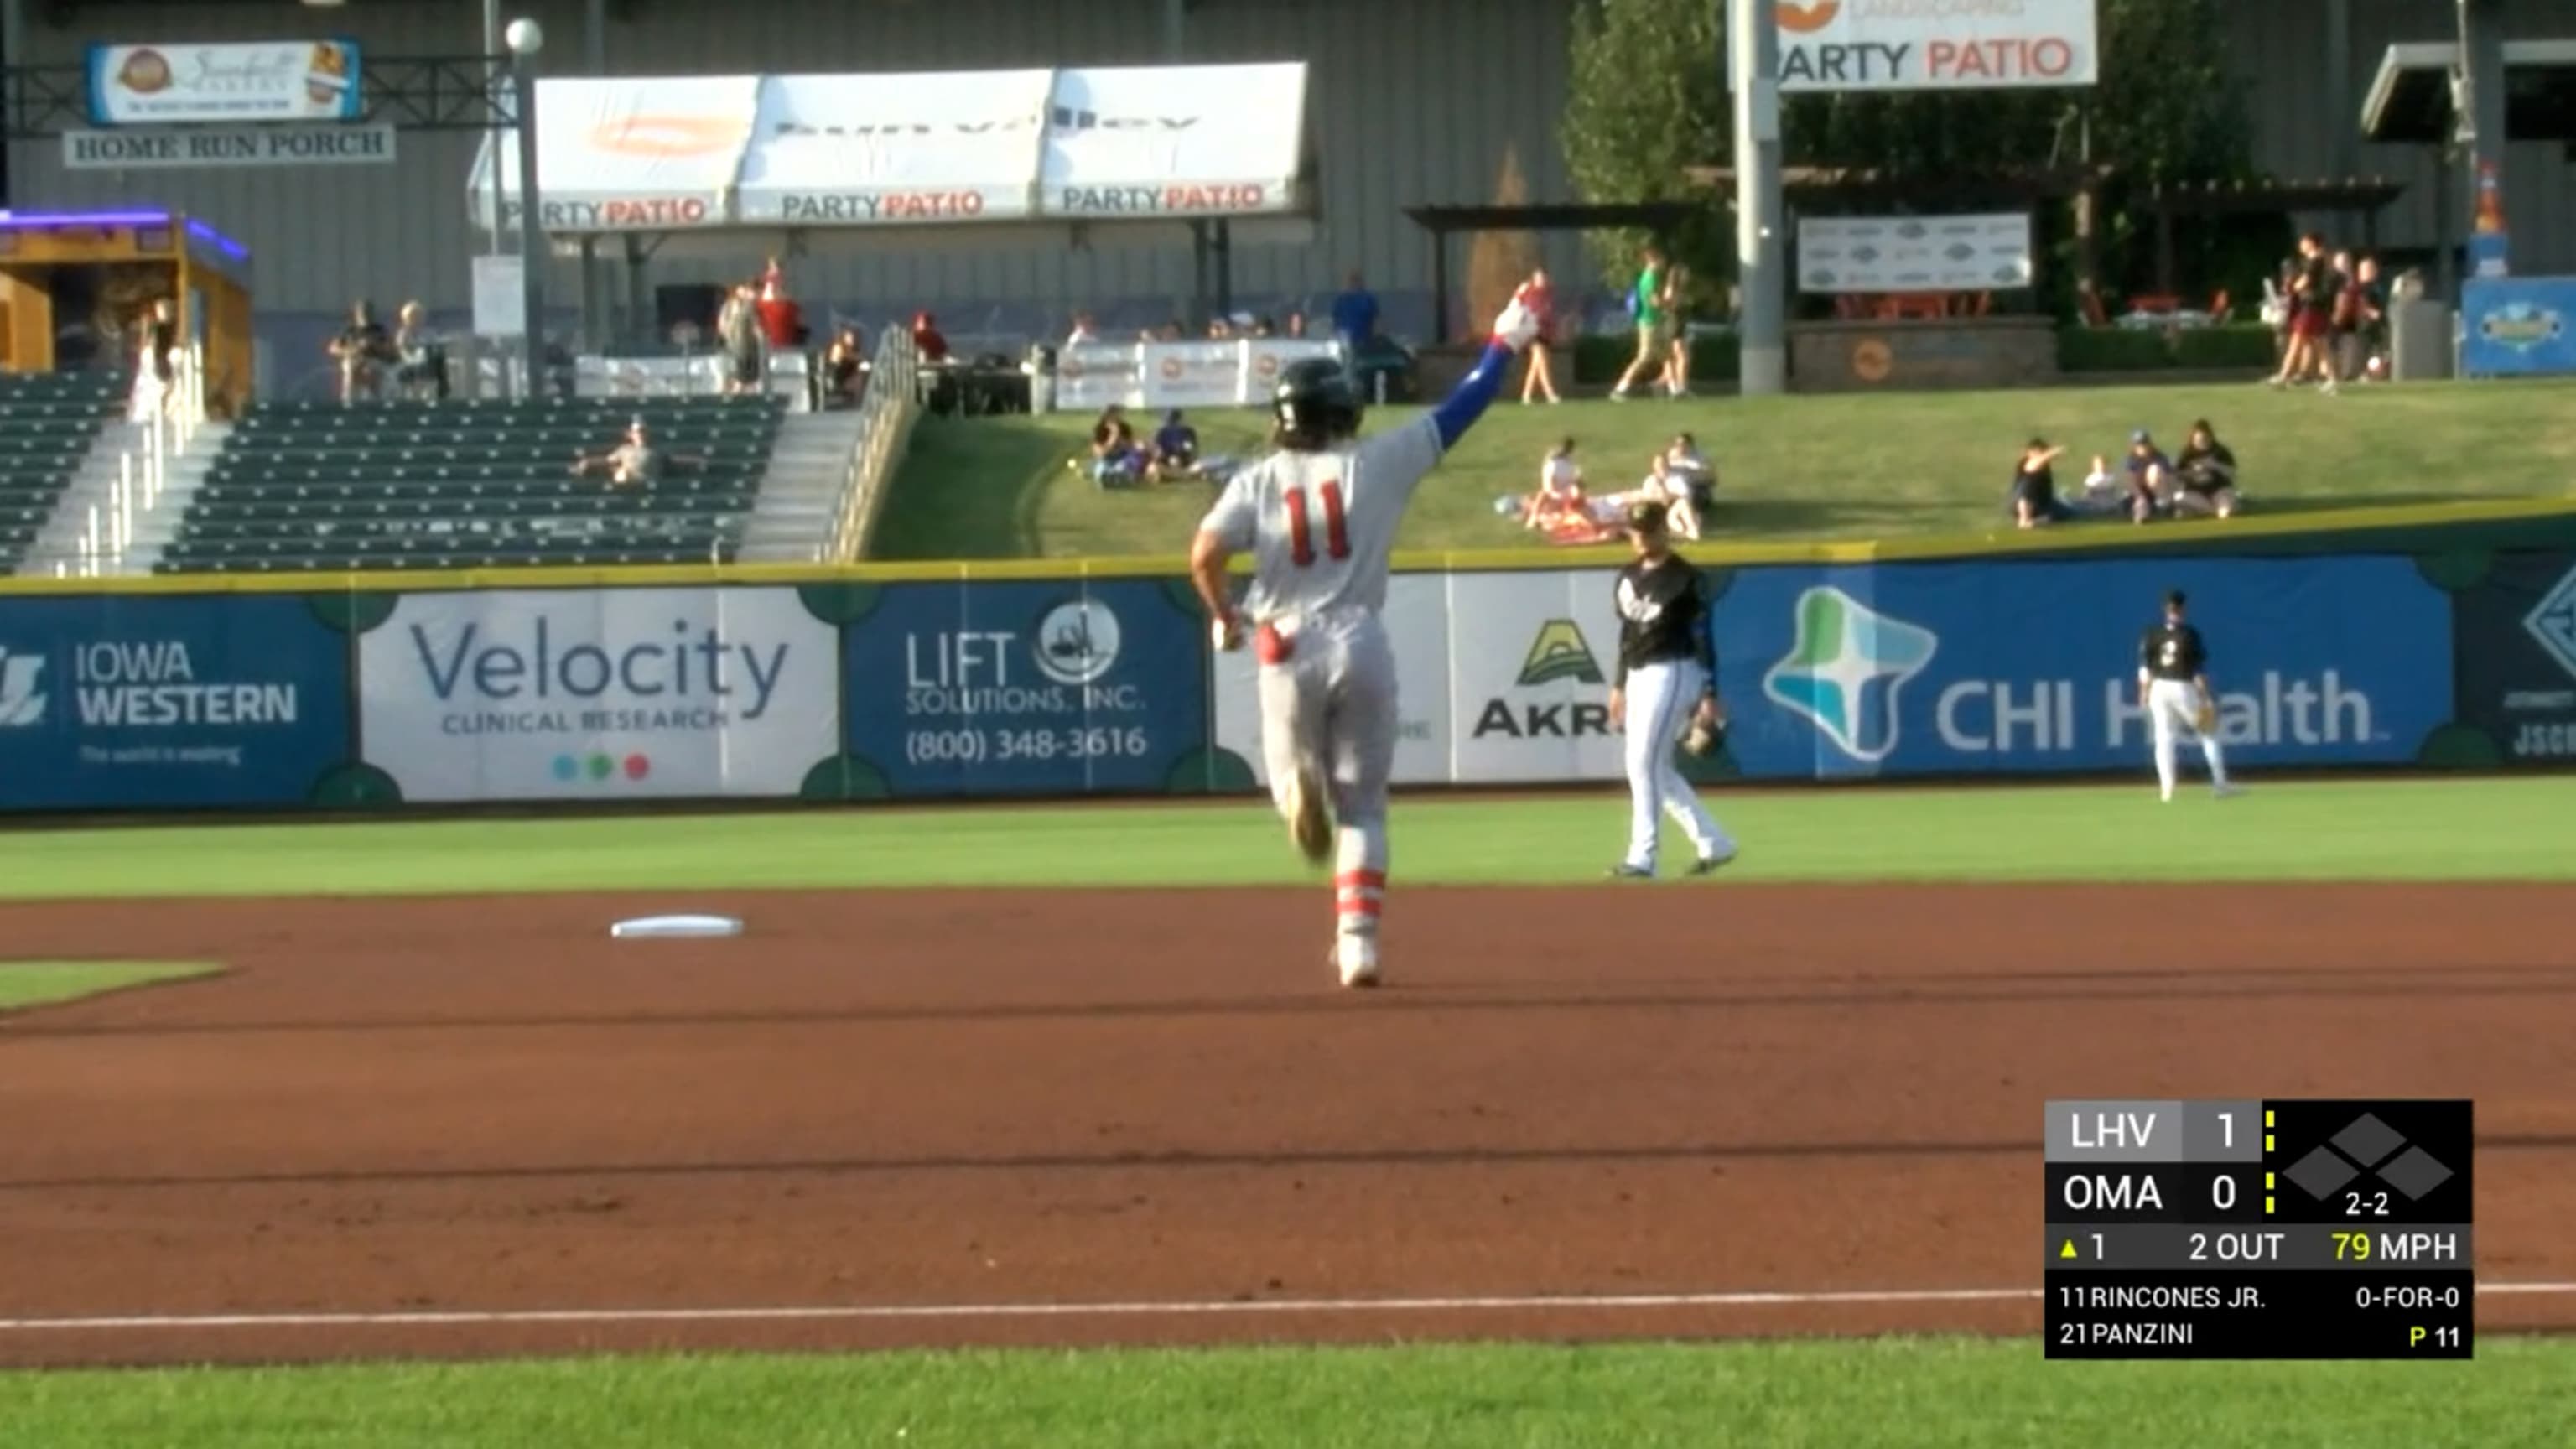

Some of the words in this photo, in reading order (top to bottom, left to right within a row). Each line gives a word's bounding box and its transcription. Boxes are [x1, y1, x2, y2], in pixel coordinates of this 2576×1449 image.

[1778, 43, 1910, 81] ARTY
[1928, 37, 2072, 78] PATIO
[75, 135, 181, 161] HOME
[189, 135, 257, 158] RUN
[269, 132, 386, 157] PORCH
[501, 201, 601, 226] PRTY
[1285, 480, 1351, 568] 11
[75, 641, 192, 682] IOWA
[410, 615, 789, 719] Velocity
[906, 631, 1016, 688] LIFT
[77, 683, 298, 725] WESTERN
[1083, 684, 1146, 709] INC.
[1936, 680, 2075, 750] CHI
[2106, 669, 2371, 748] Halth
[442, 712, 573, 735] CLINICAL
[581, 709, 730, 731] RESEARCH
[1472, 698, 1625, 738] AKR
[907, 729, 987, 763] (800)
[995, 726, 1148, 758] 348-3616
